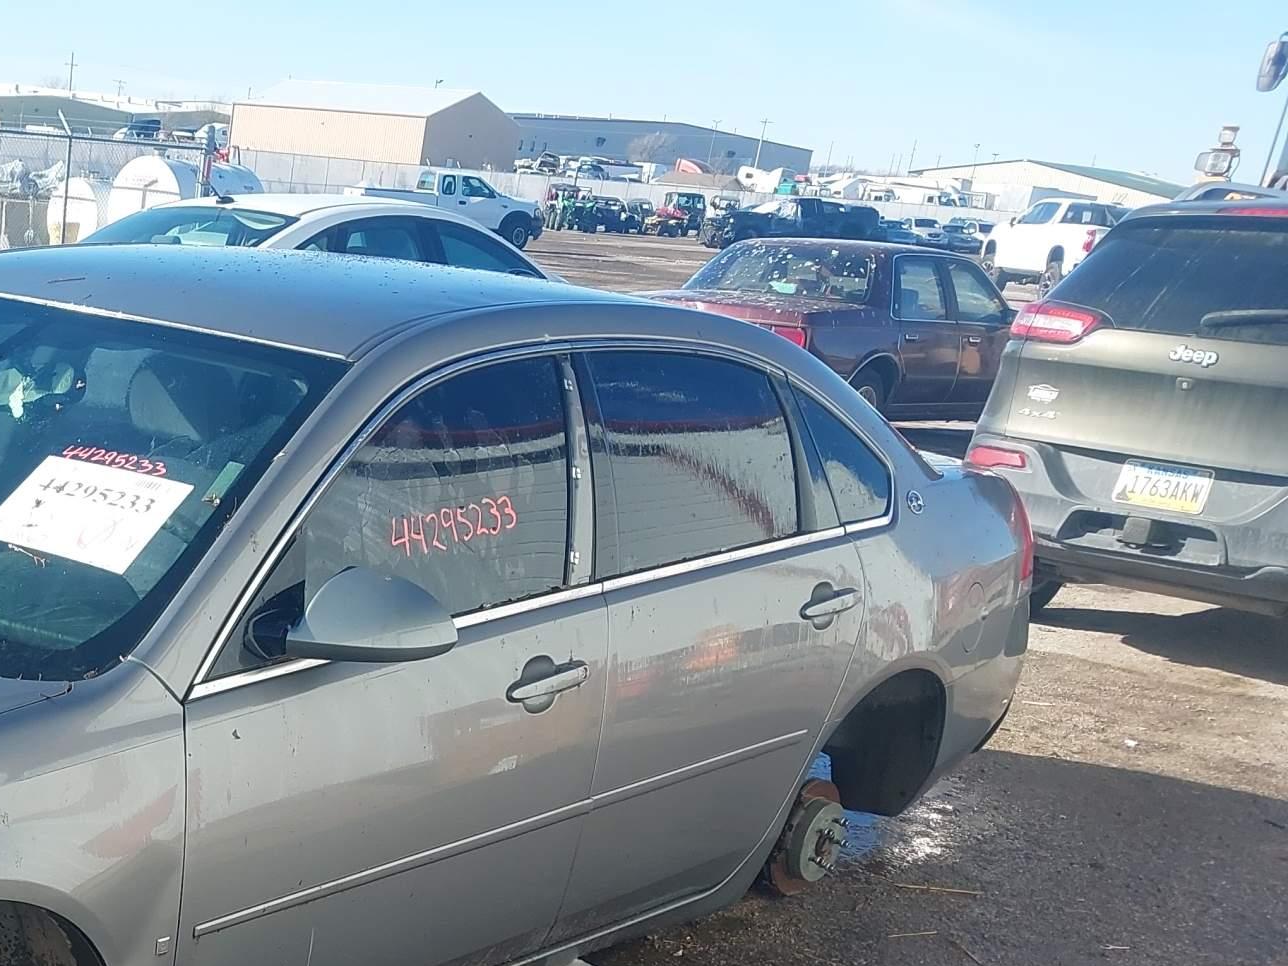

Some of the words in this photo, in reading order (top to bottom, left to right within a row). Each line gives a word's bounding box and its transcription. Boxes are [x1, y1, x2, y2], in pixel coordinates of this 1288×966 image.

[1169, 345, 1219, 367] Jeep
[62, 445, 167, 476] 44295233
[1128, 475, 1205, 504] 1763AKW
[391, 495, 517, 557] 44295233
